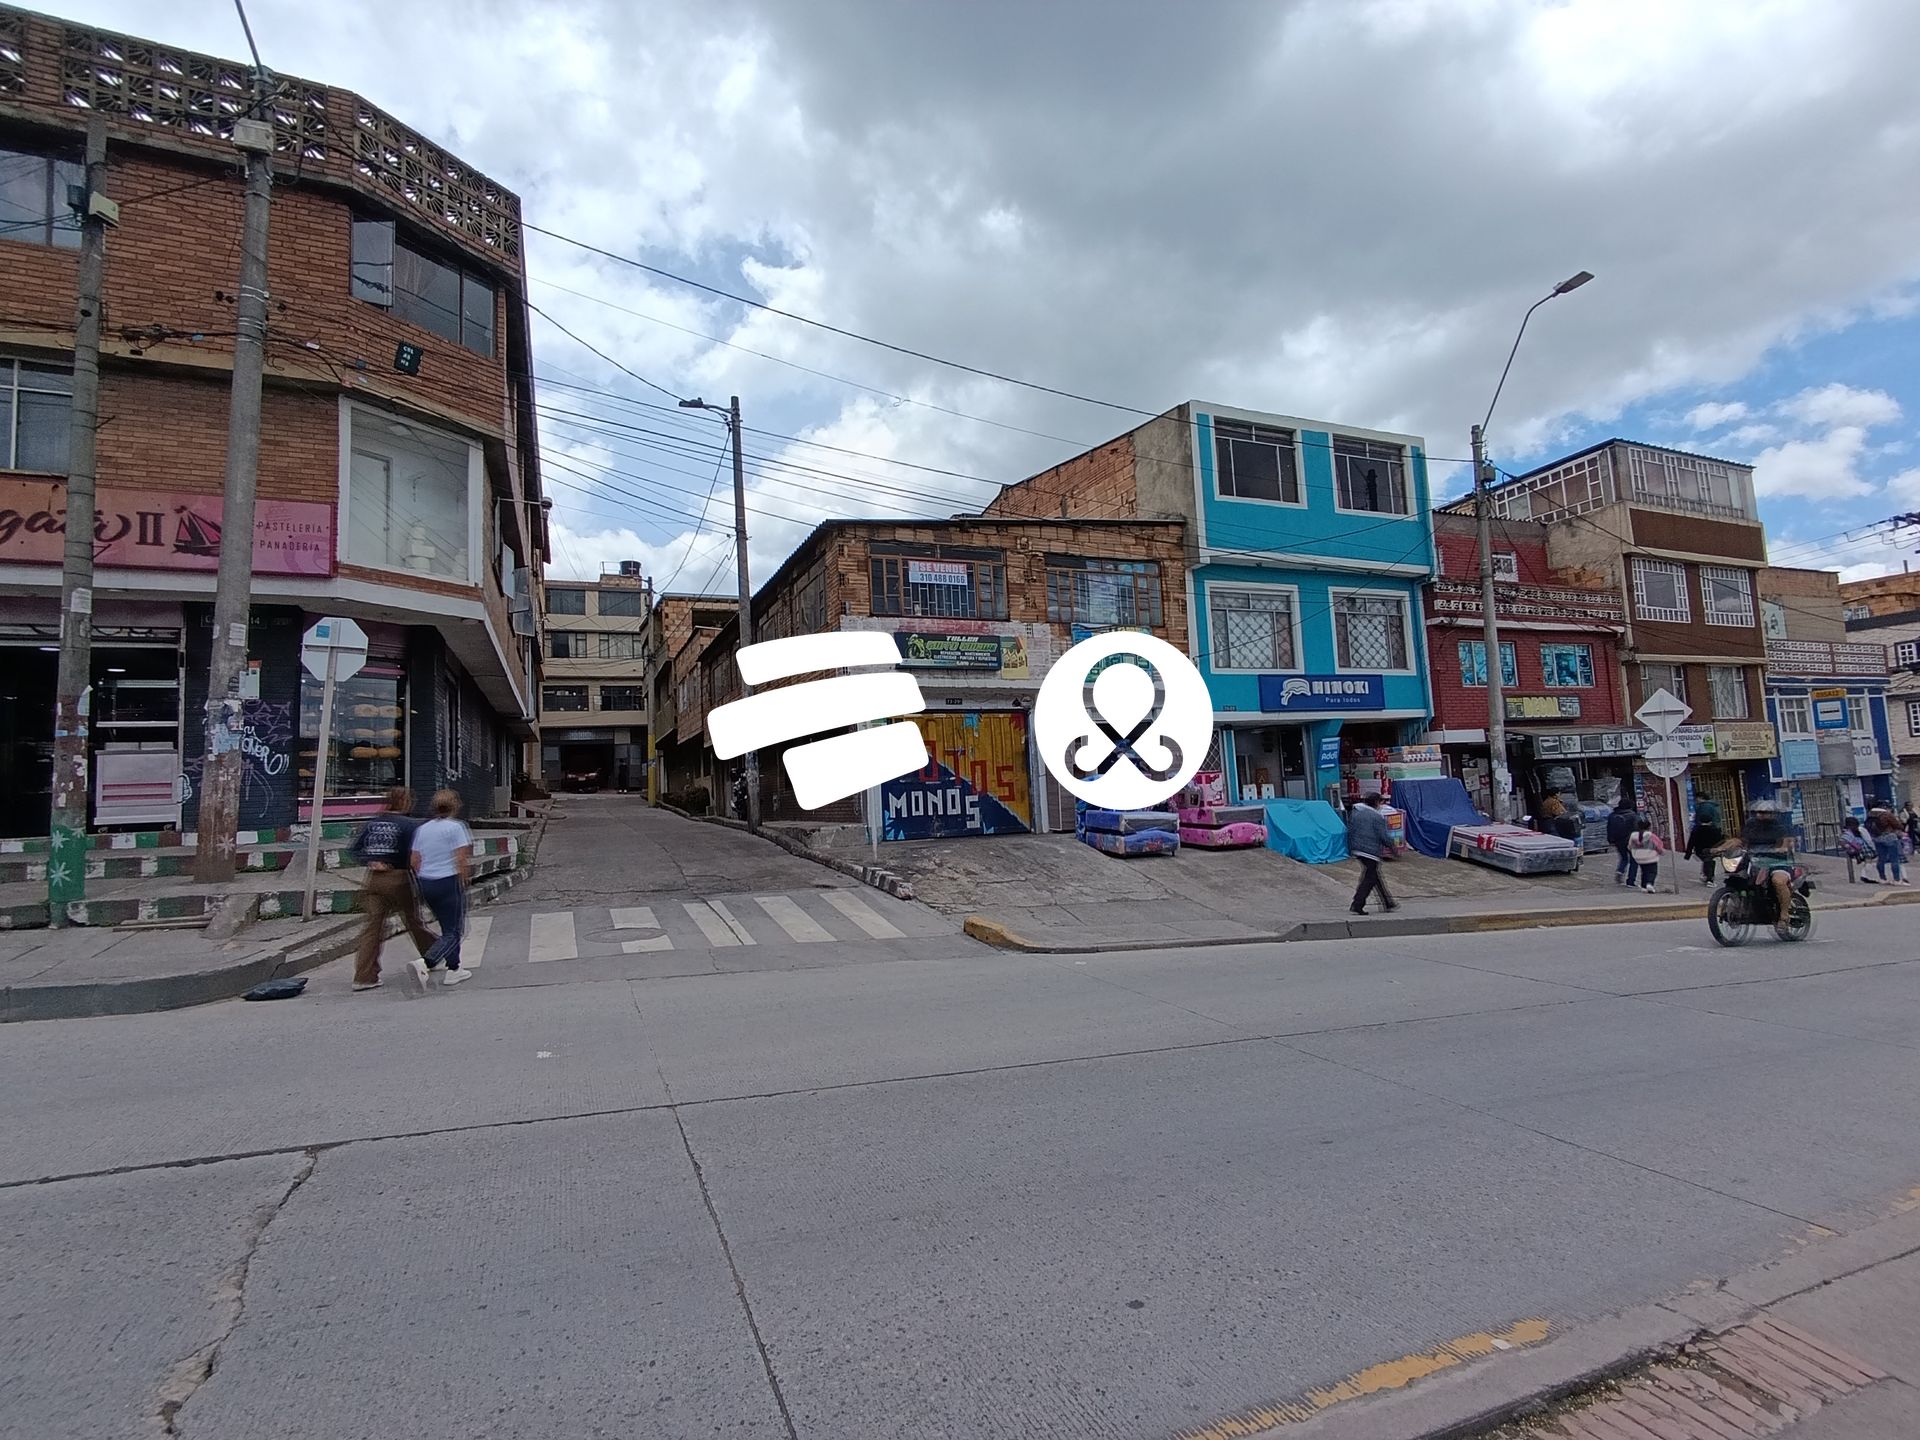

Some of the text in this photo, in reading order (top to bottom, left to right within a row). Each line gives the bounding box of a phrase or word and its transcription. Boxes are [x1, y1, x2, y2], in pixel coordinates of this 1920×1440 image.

[919, 562, 964, 573] SE VENDE
[888, 789, 980, 830] MONOS
